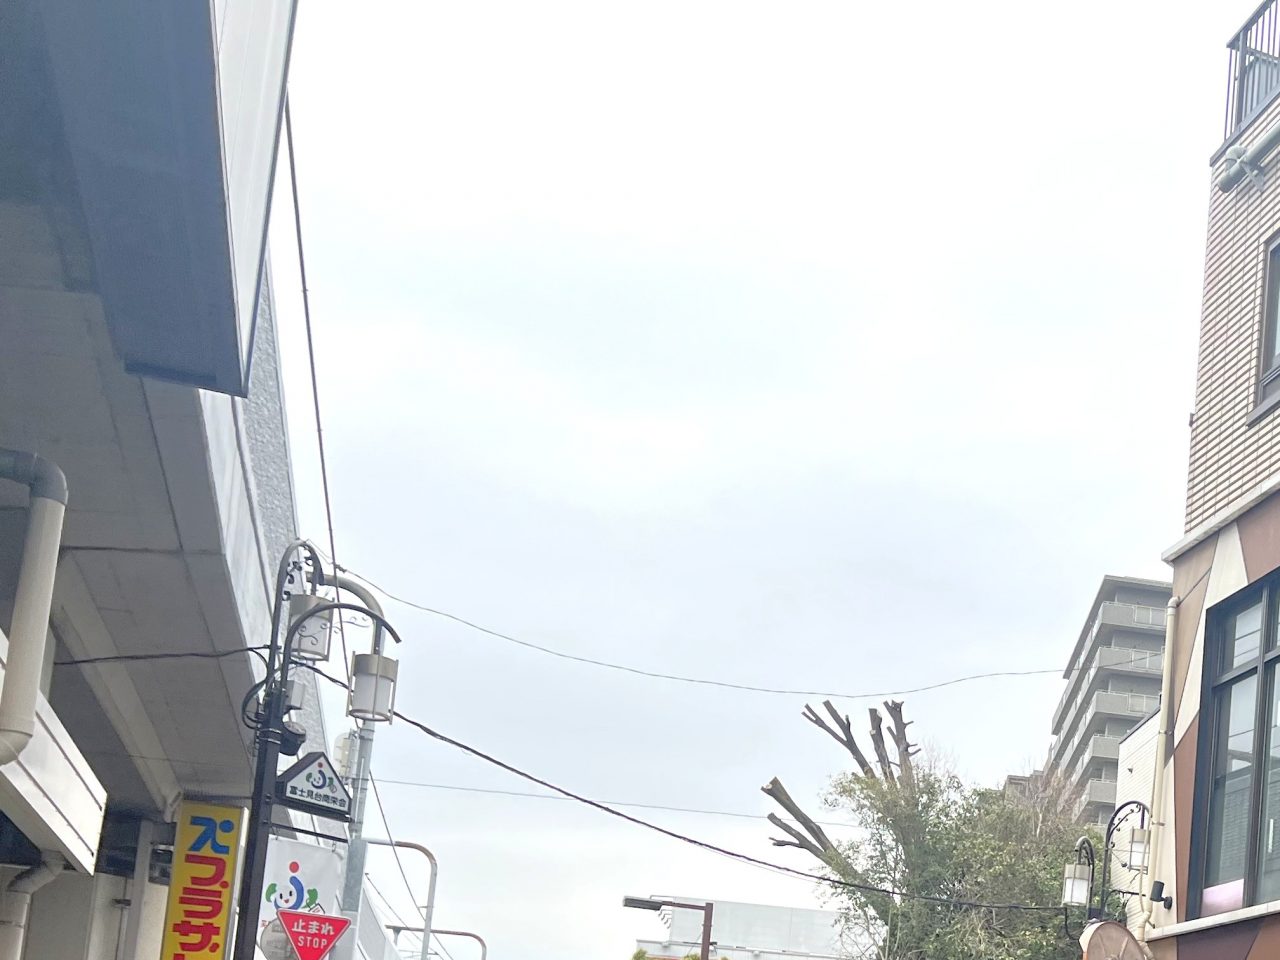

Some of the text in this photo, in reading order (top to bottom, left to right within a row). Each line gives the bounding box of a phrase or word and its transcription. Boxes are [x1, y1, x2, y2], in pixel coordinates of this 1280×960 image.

[291, 919, 335, 935] 止まれ
[297, 935, 328, 949] STOP
